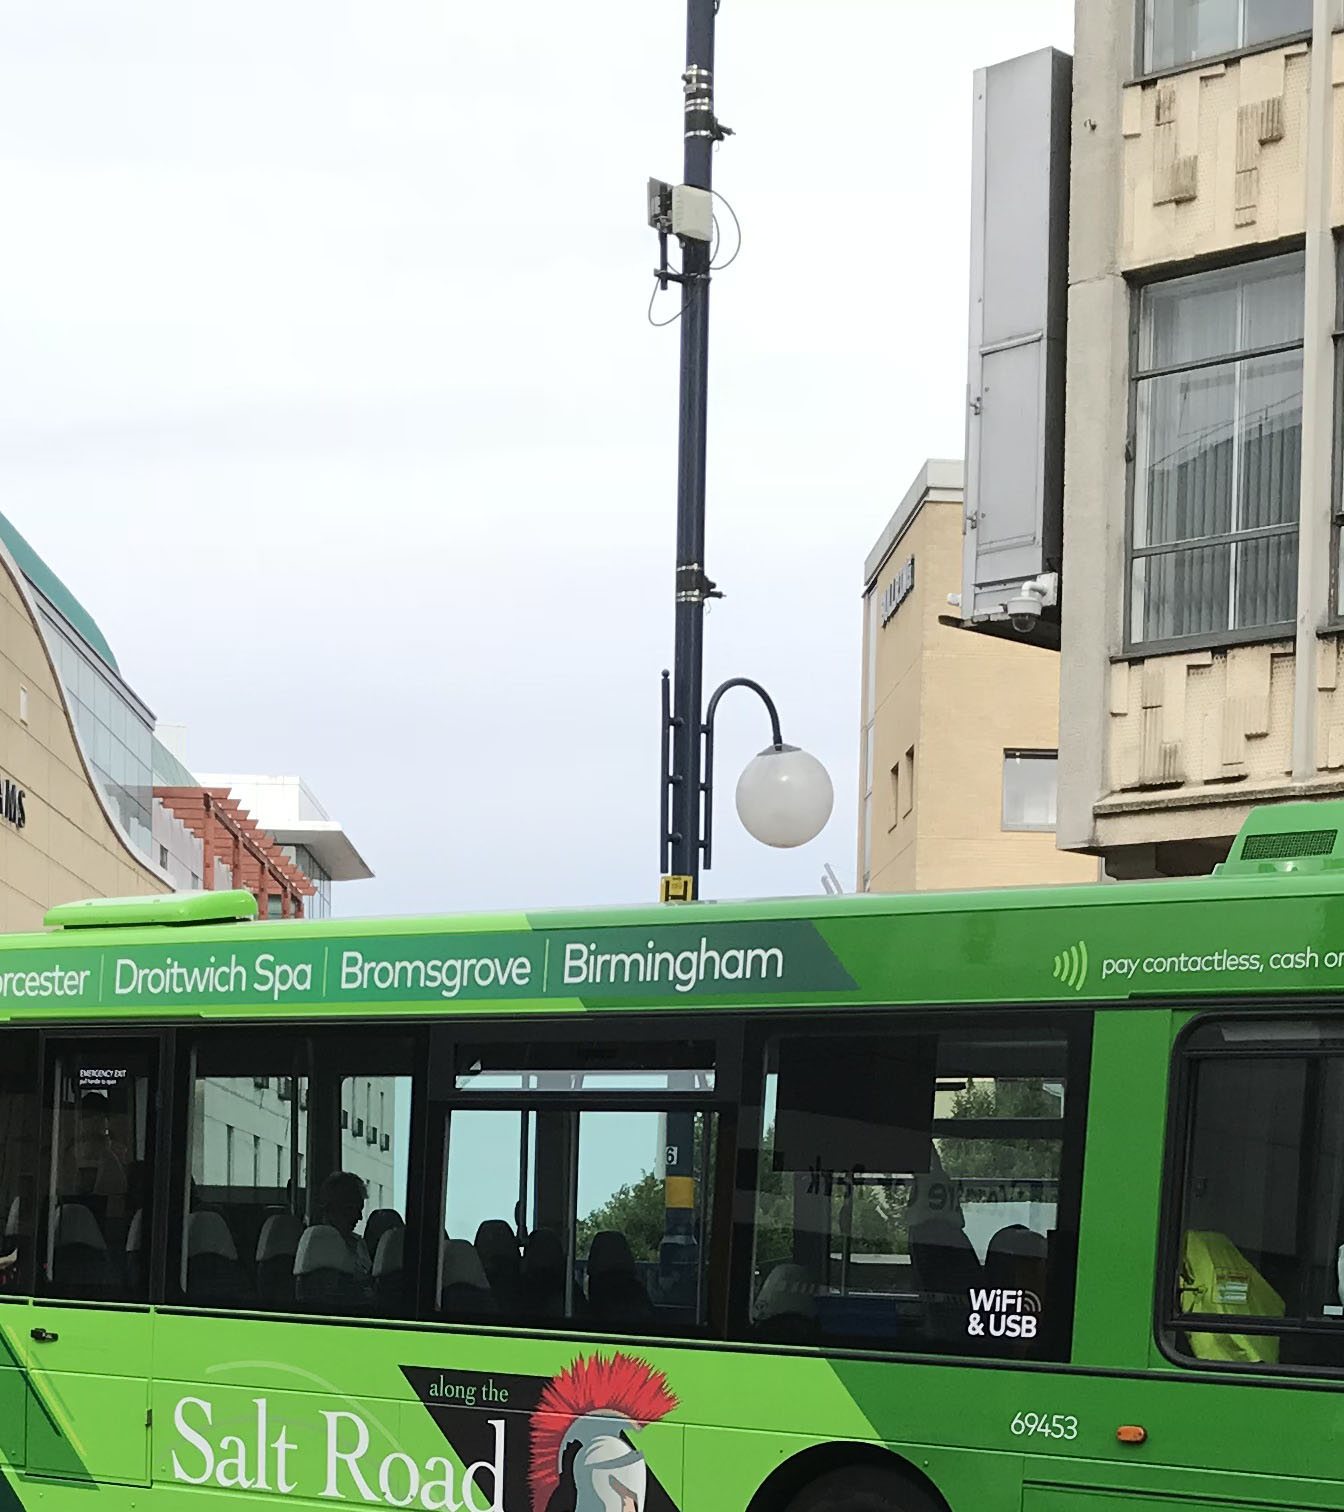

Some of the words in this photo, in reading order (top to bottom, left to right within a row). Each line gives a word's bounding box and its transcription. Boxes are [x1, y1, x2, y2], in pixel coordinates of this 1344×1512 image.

[114, 954, 246, 995] Droitwich
[253, 953, 312, 1000] Spa
[340, 951, 531, 997] Bromsgrove
[563, 937, 783, 992] Birmingham
[1102, 957, 1140, 979] pay
[1142, 949, 1264, 973] contactless,
[1269, 946, 1318, 970] cash
[666, 1147, 675, 1164] 6
[969, 1288, 1023, 1312] WiFi
[967, 1312, 985, 1336] &
[989, 1313, 1037, 1338] USB
[429, 1375, 477, 1405] along
[482, 1378, 509, 1402] the
[1010, 1411, 1078, 1440] 69453
[171, 1396, 298, 1493] Salt
